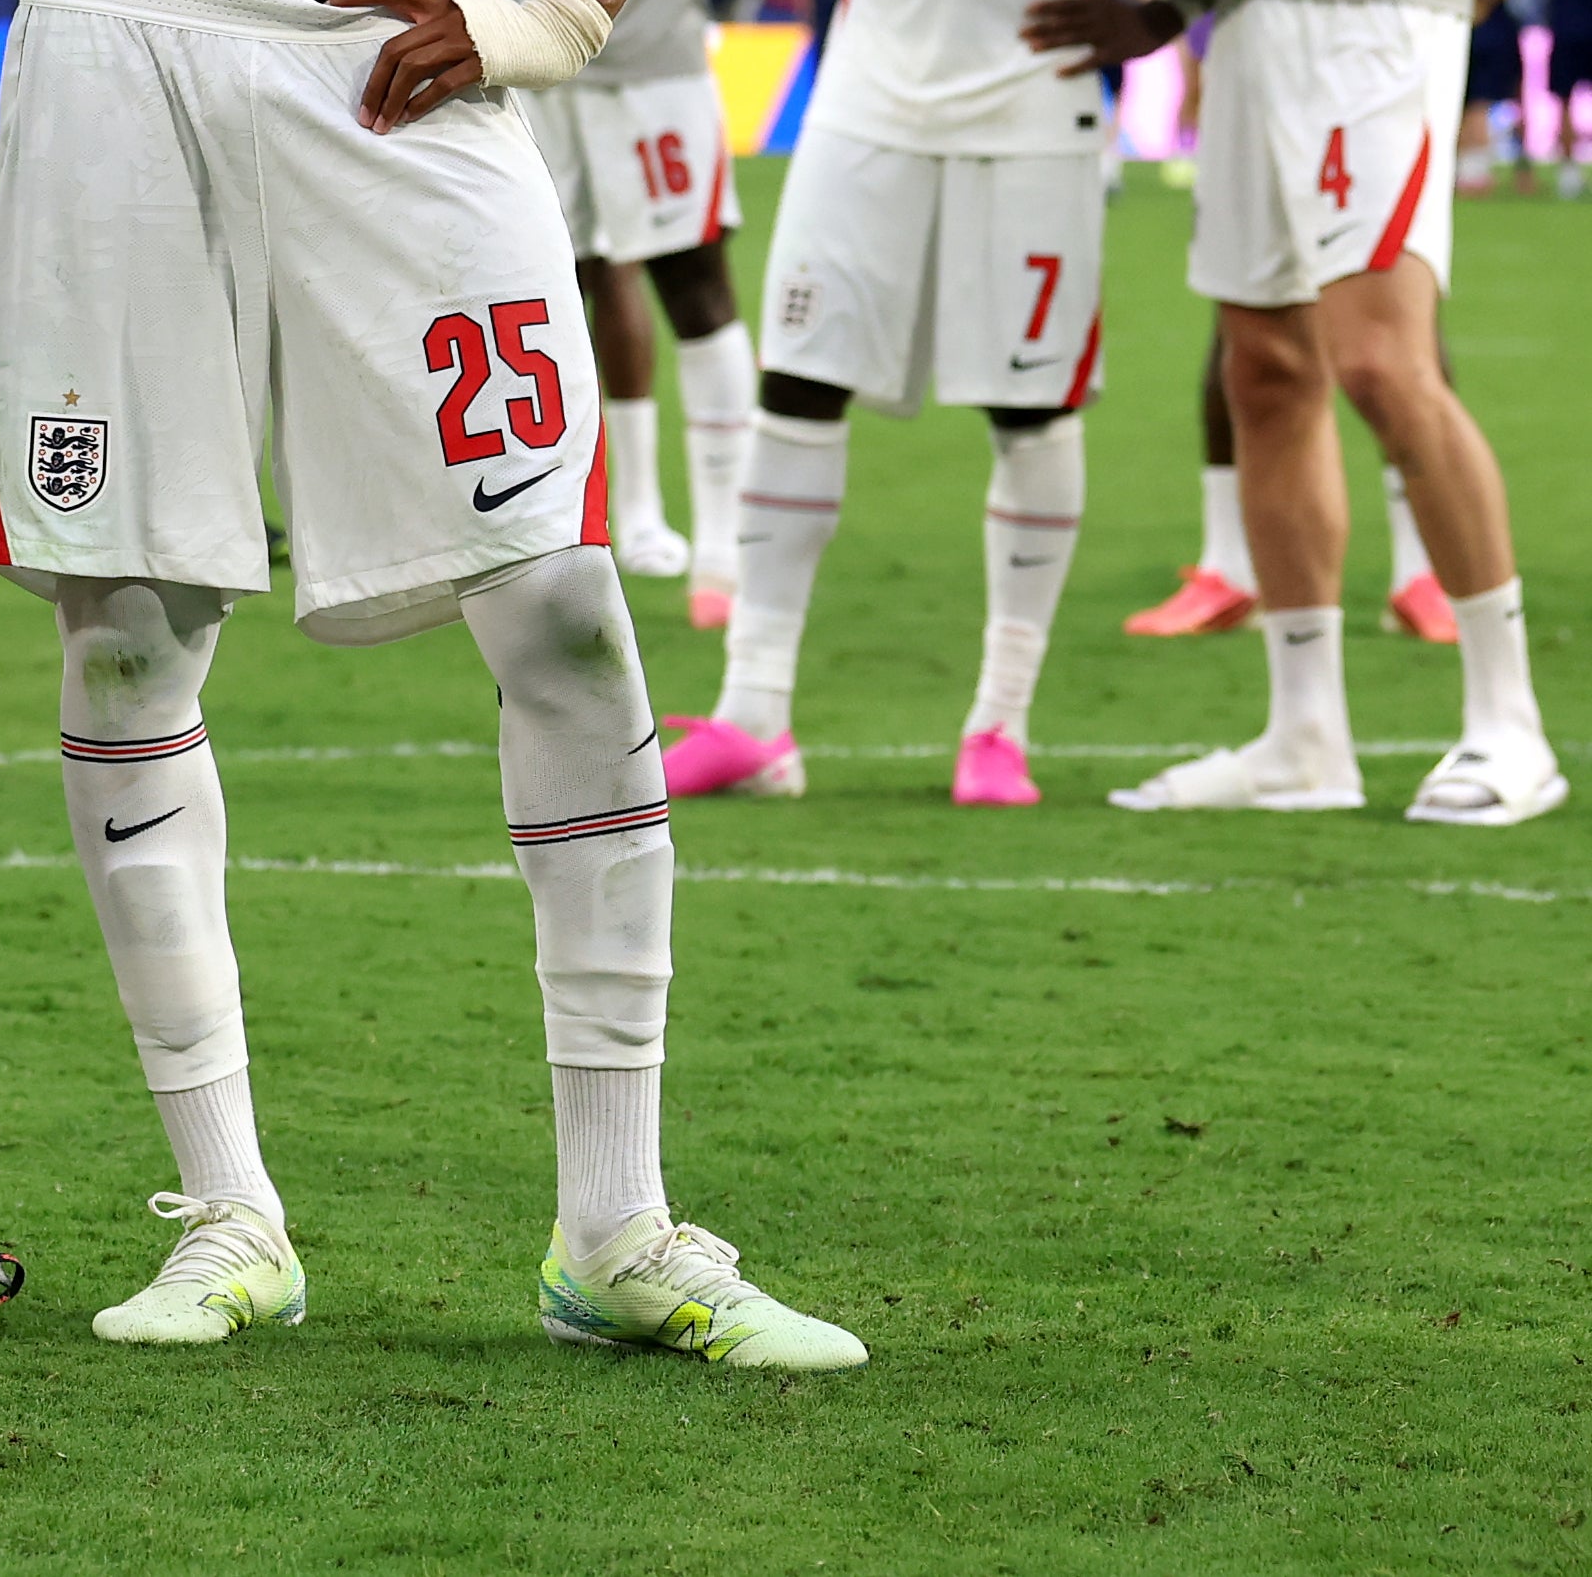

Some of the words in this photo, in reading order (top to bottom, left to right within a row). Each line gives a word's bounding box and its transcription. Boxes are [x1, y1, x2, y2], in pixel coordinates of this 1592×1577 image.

[634, 131, 693, 199] 16
[1317, 125, 1353, 210] 4
[1025, 254, 1062, 342] 7
[422, 297, 568, 467] 25
